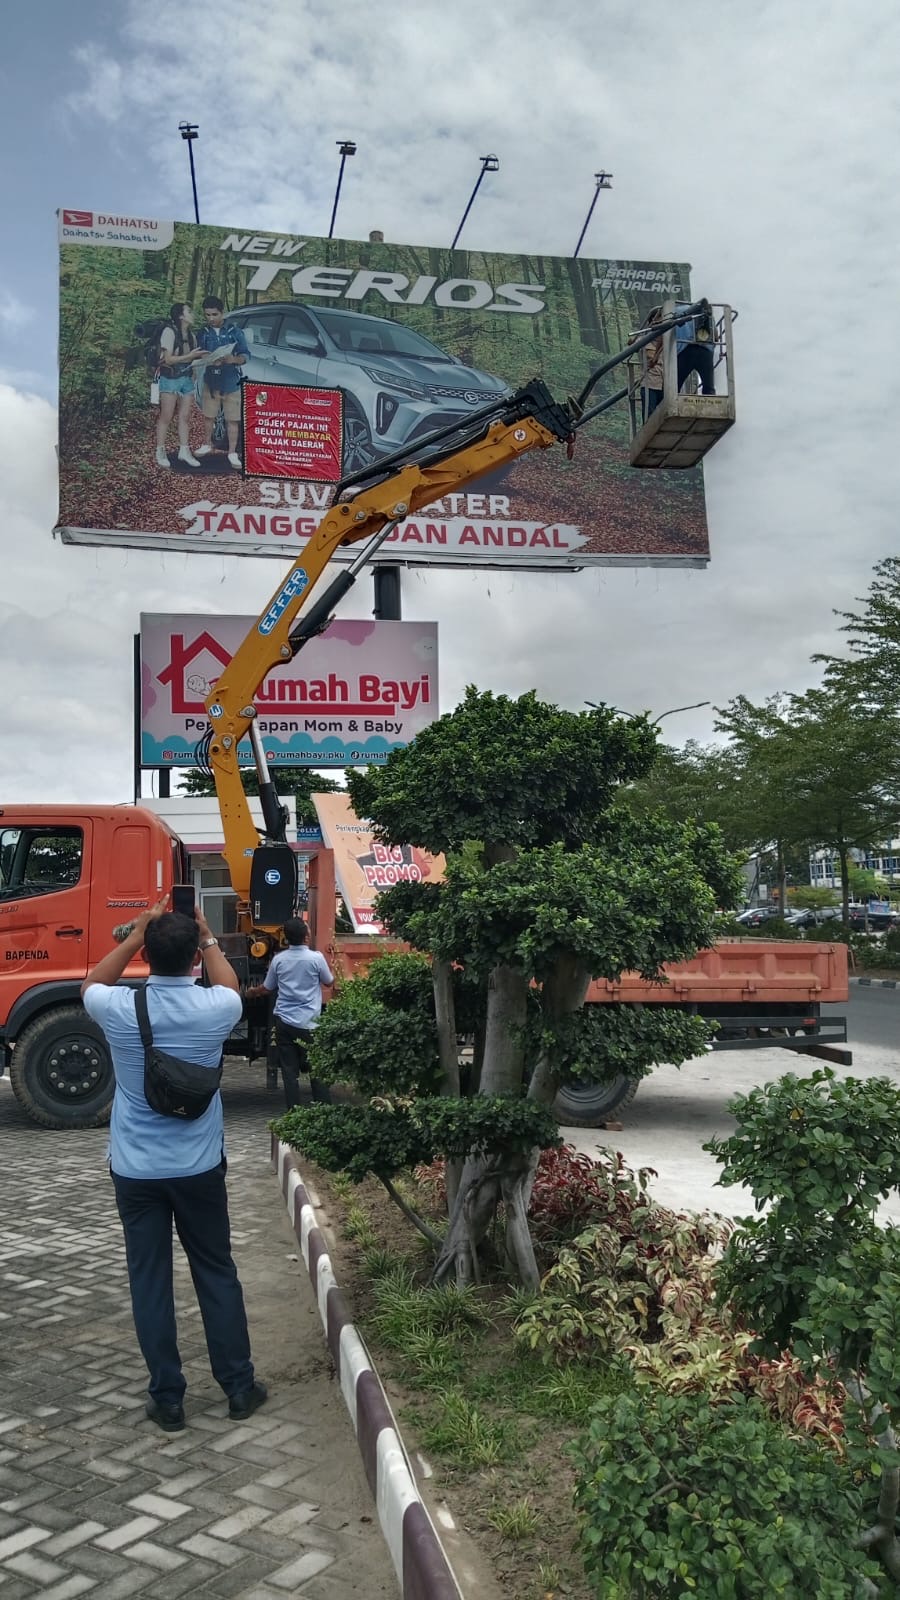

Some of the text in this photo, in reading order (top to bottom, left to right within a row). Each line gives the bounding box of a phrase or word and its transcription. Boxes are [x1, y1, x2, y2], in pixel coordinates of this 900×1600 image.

[98, 216, 158, 230] DAIHATSU
[62, 228, 105, 239] Daihatsu
[219, 234, 307, 257] NEW
[605, 268, 677, 281] SAHABAT
[238, 258, 547, 314] TERIOS
[591, 277, 682, 294] PETUALANG
[254, 427, 331, 441] BELUM MEMBAYAR
[258, 419, 328, 432] OBJEK PAJAK INI
[262, 437, 324, 449] PAJAK DAERAH
[259, 481, 331, 507] SUV
[458, 526, 569, 548] ANDAL
[261, 570, 304, 631] EFFER
[255, 673, 429, 709] umah Bayi
[304, 719, 343, 732] Mom
[348, 719, 359, 732] &
[364, 720, 403, 734] Baby
[373, 843, 403, 864] BIG
[363, 864, 422, 887] PROMO
[5, 950, 49, 961] BAPENDA
